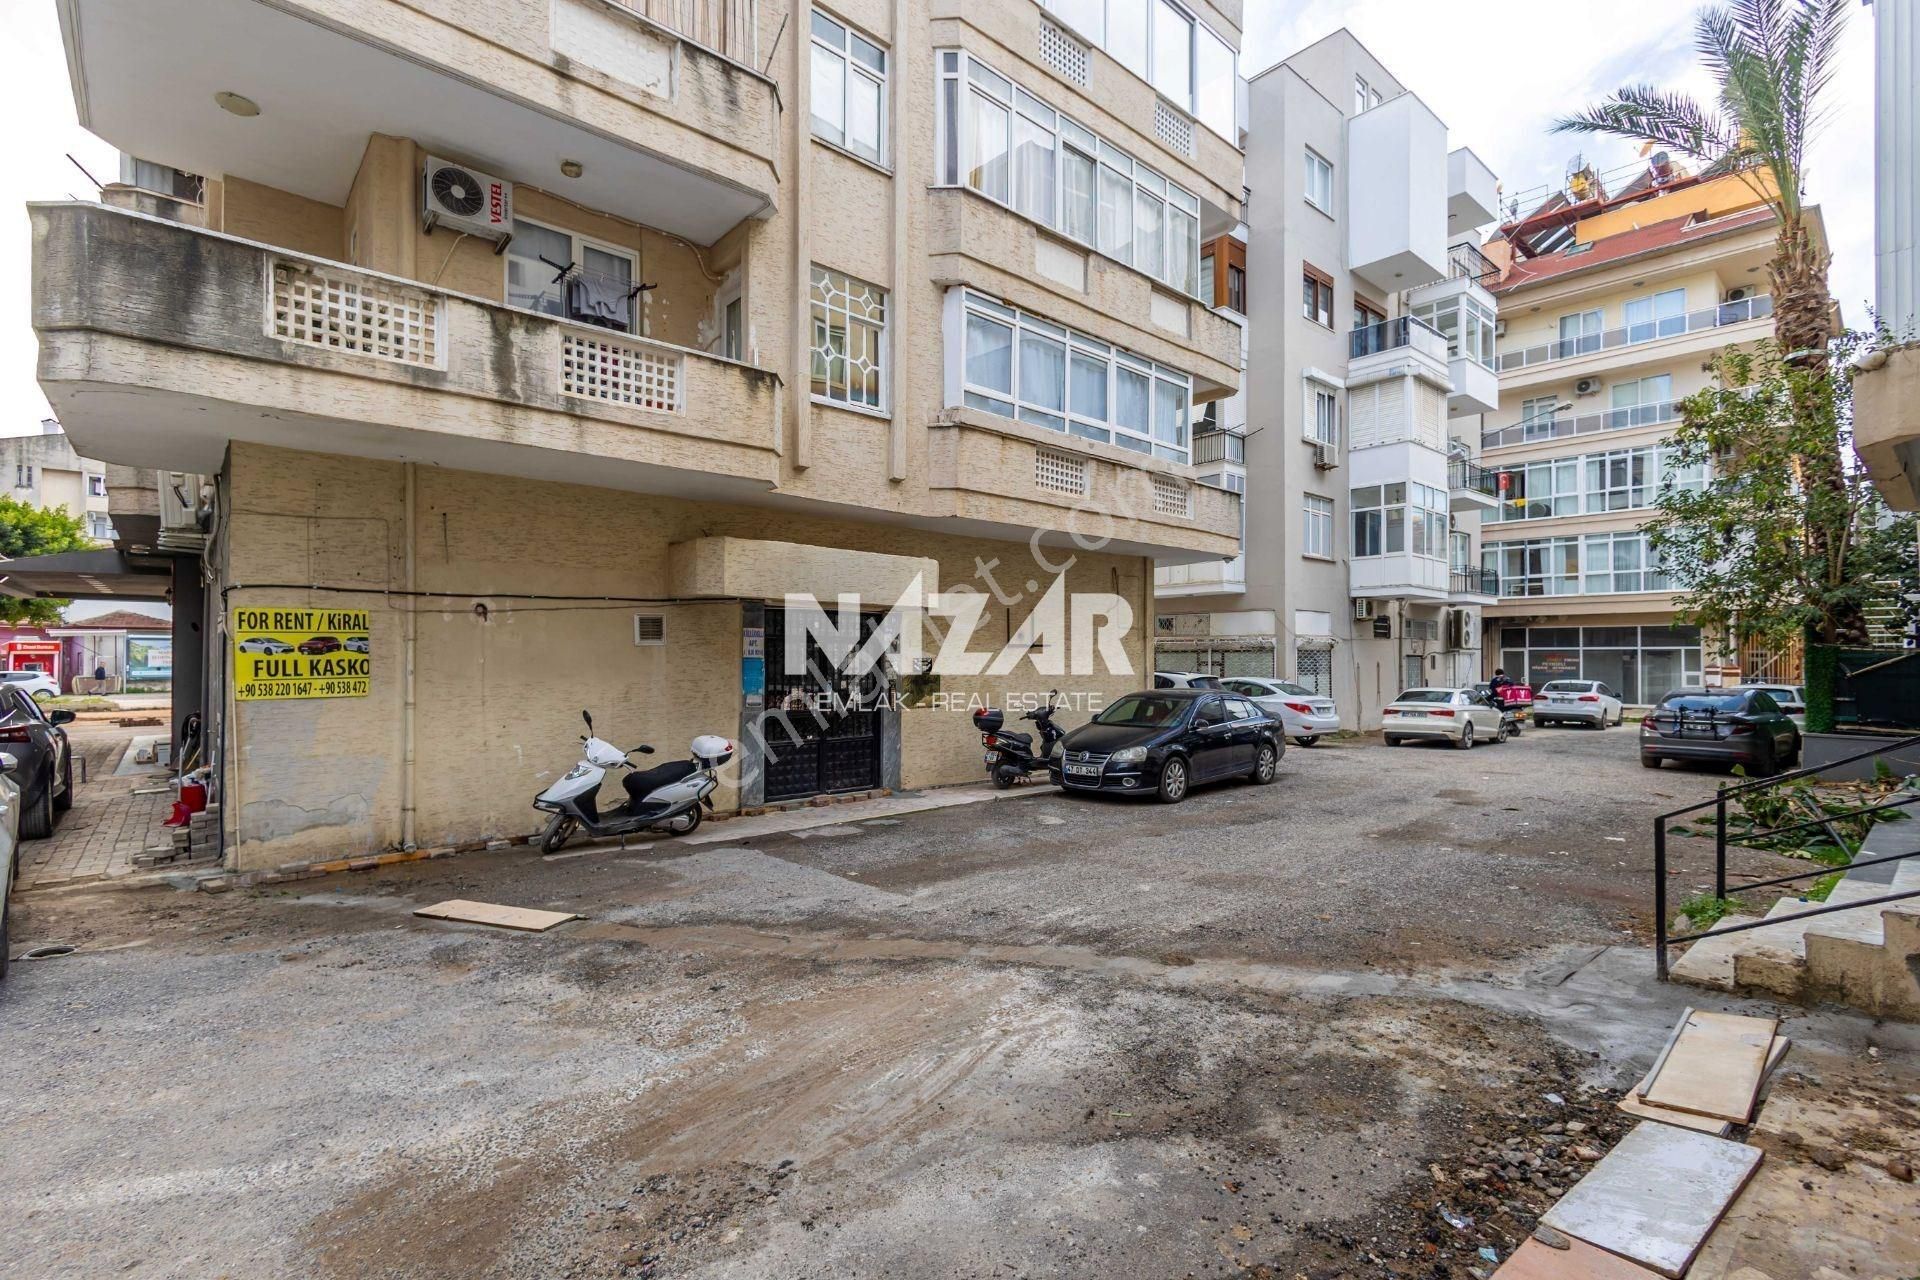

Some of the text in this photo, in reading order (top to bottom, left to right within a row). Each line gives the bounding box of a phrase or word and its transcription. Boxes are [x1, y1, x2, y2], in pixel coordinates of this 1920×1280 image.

[490, 183, 502, 224] VESTEL
[238, 611, 269, 630] FOR
[274, 612, 314, 630] RENT
[317, 612, 324, 631] /
[253, 658, 370, 678] FULL KASKO
[238, 683, 256, 697] +90
[257, 683, 273, 697] 538
[275, 682, 291, 696] 220
[293, 682, 313, 695] 1647
[319, 681, 336, 695] +90
[336, 680, 351, 694] 538
[352, 680, 367, 694] 472
